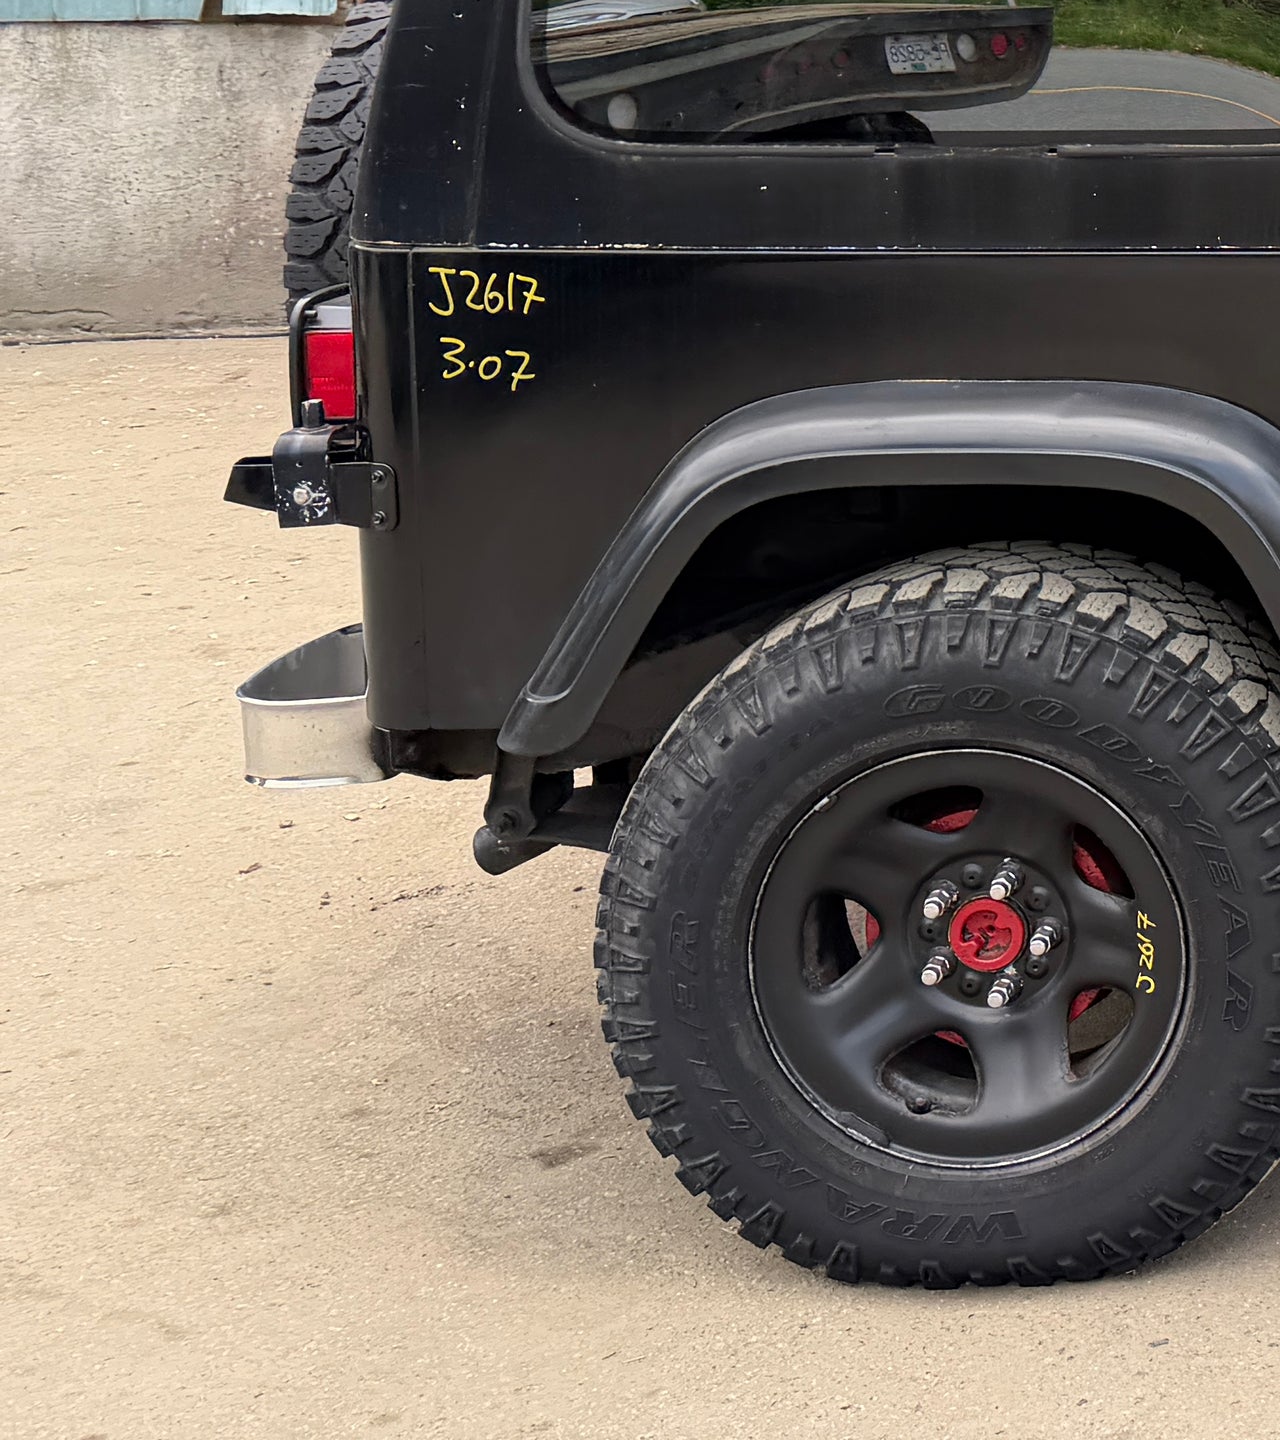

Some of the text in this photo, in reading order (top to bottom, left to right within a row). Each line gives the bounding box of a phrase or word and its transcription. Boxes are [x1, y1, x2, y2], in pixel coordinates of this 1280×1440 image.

[427, 266, 546, 317] J2617
[882, 682, 1255, 1032] GOODYEAR
[1136, 911, 1157, 994] J2617
